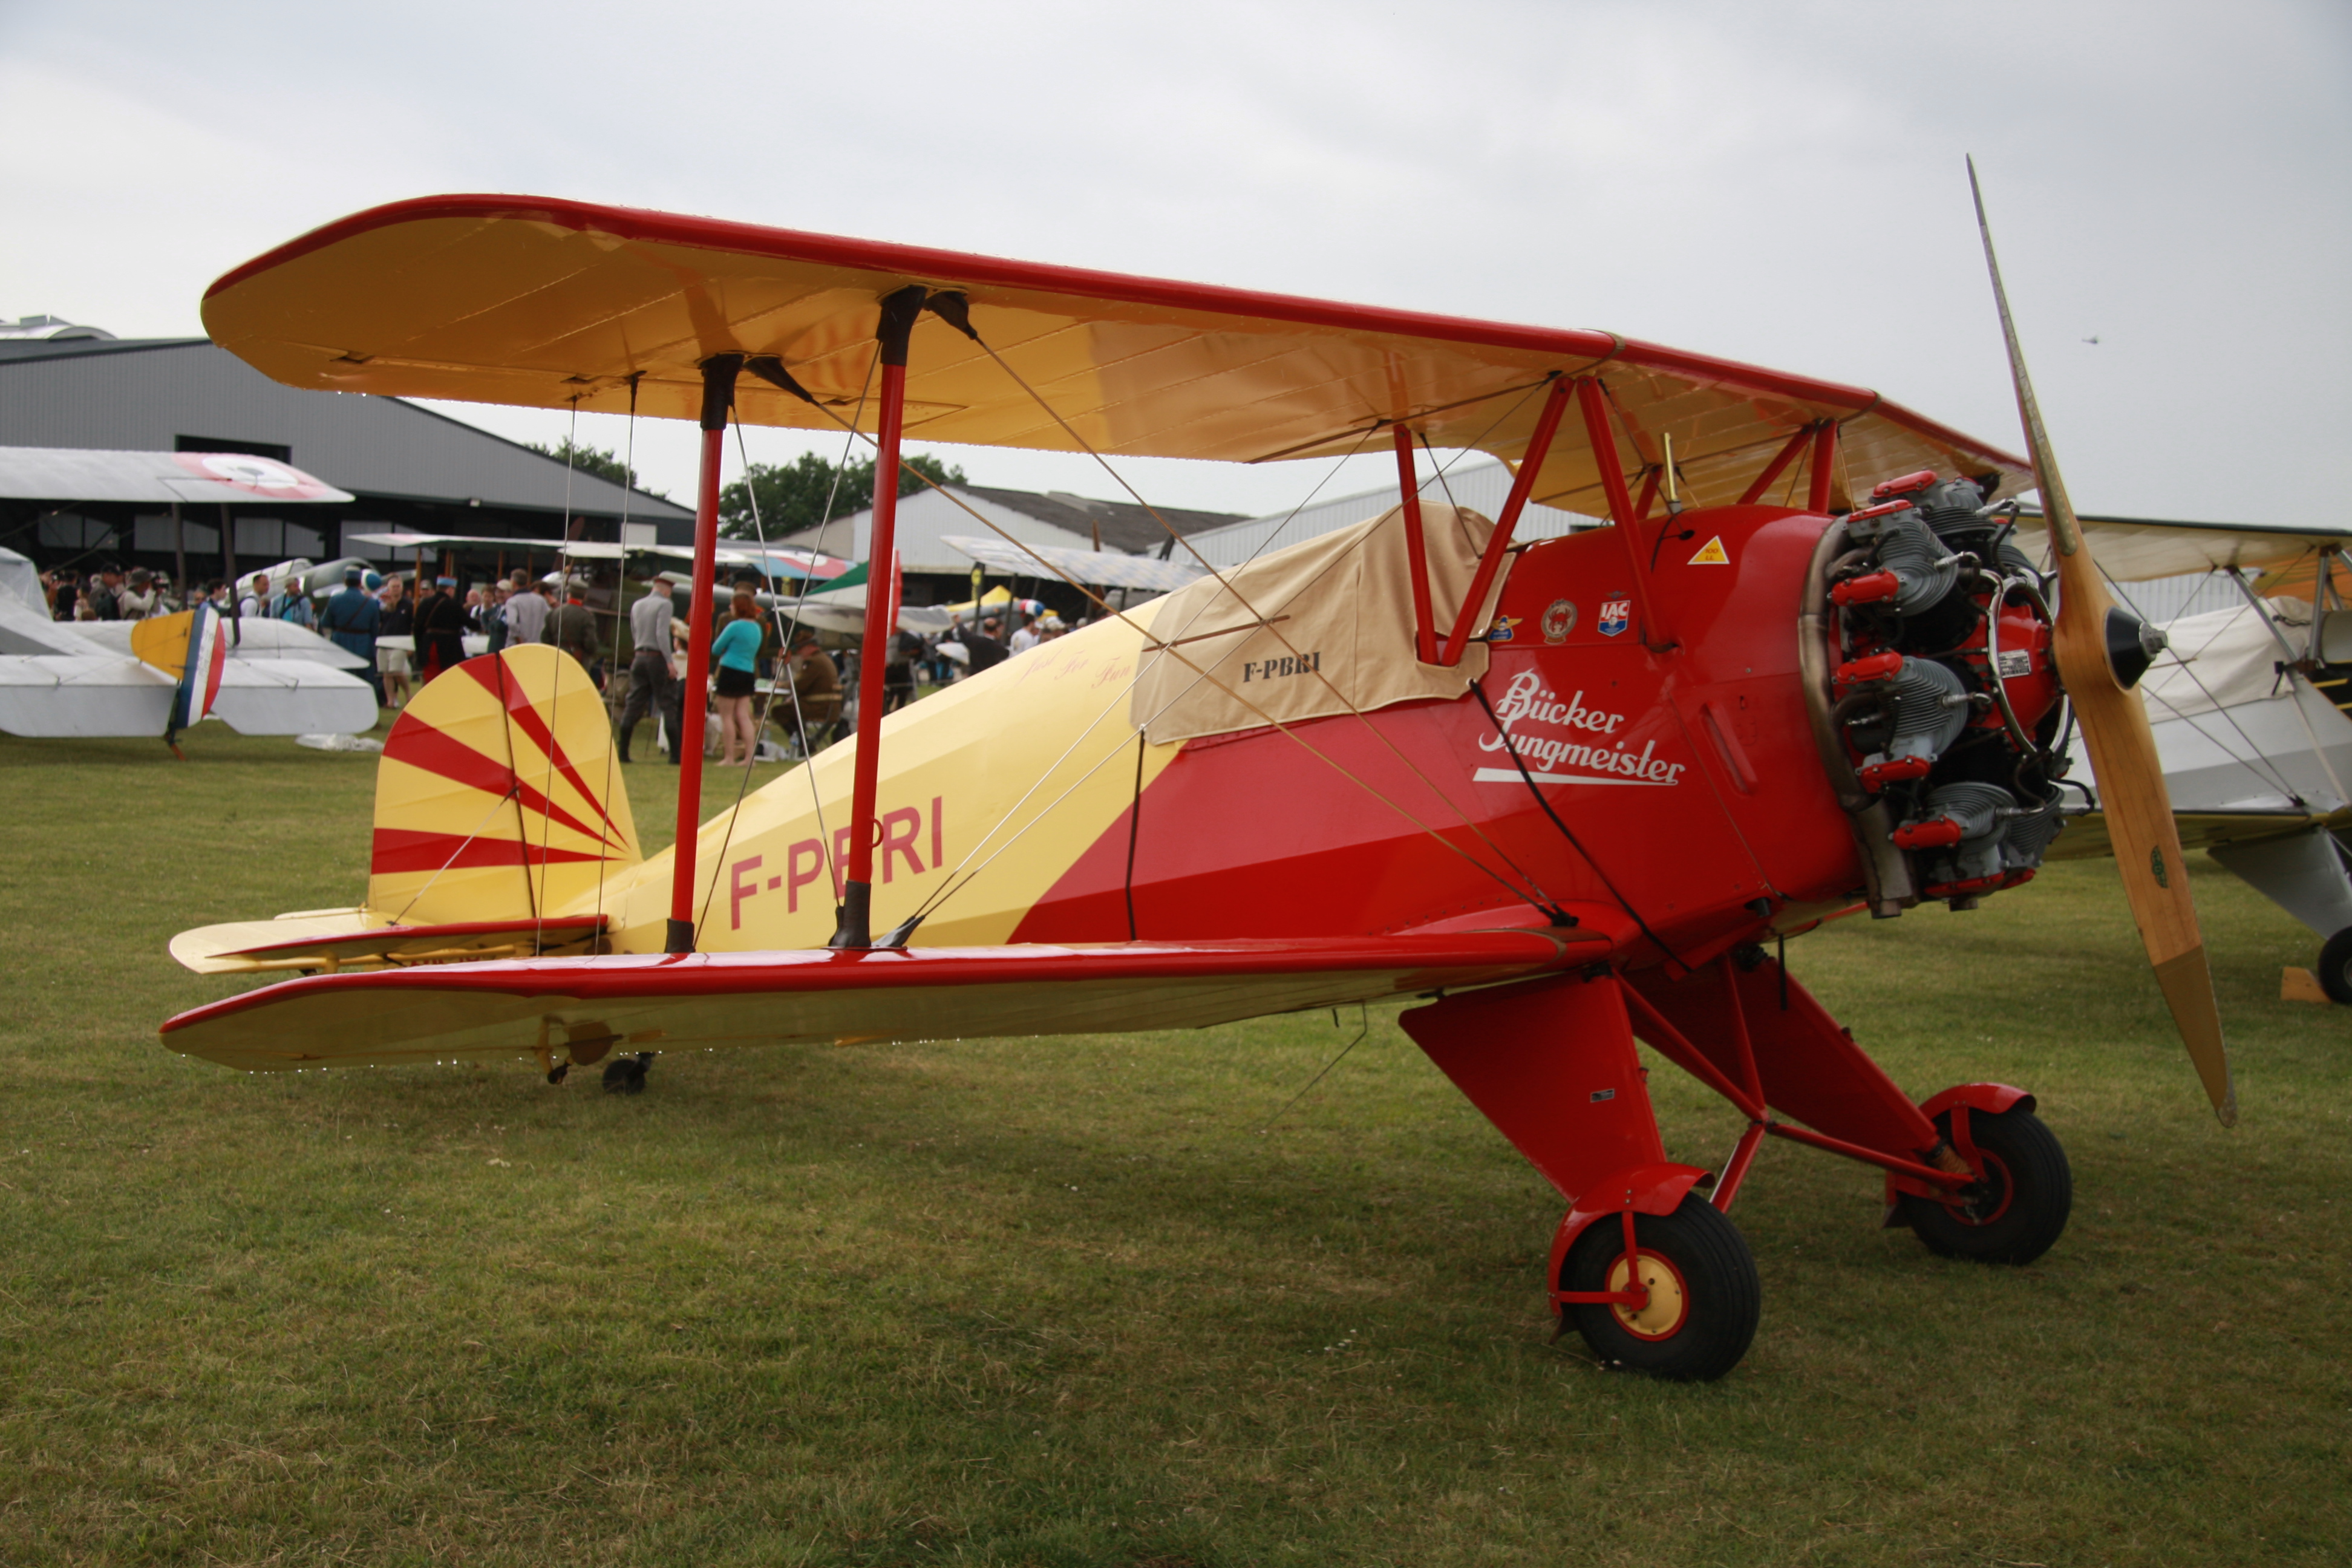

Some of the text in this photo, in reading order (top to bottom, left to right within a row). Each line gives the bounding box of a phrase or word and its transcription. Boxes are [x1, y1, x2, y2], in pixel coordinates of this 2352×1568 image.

[1601, 603, 1628, 620] IAC
[1091, 656, 1131, 689] Fun
[1243, 652, 1321, 683] F-PBRI
[1494, 667, 1624, 734] Bücker
[1478, 699, 1686, 785] Jungmeister
